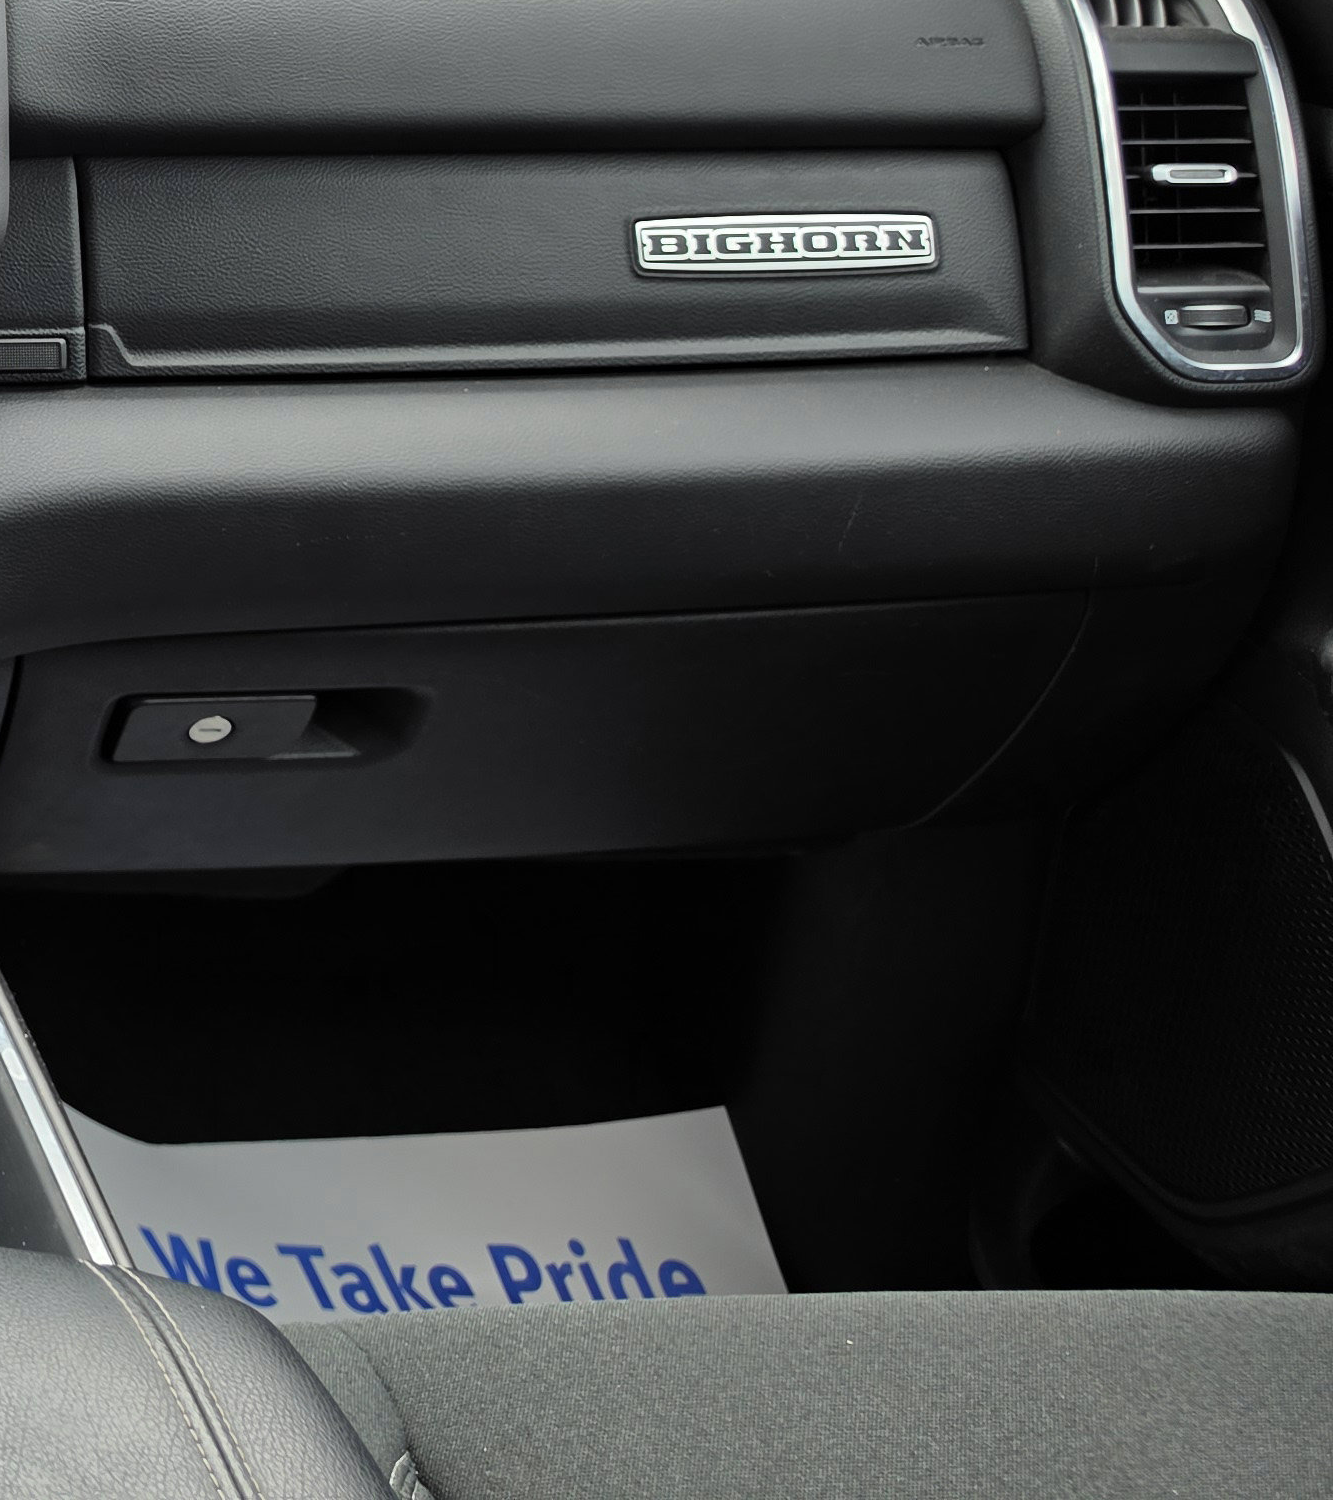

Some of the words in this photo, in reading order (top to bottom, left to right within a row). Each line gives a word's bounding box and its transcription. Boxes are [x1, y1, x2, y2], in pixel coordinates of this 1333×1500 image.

[645, 228, 929, 259] BIGHORN
[140, 1228, 277, 1309] We
[277, 1243, 476, 1315] Take
[486, 1237, 707, 1307] Pride
